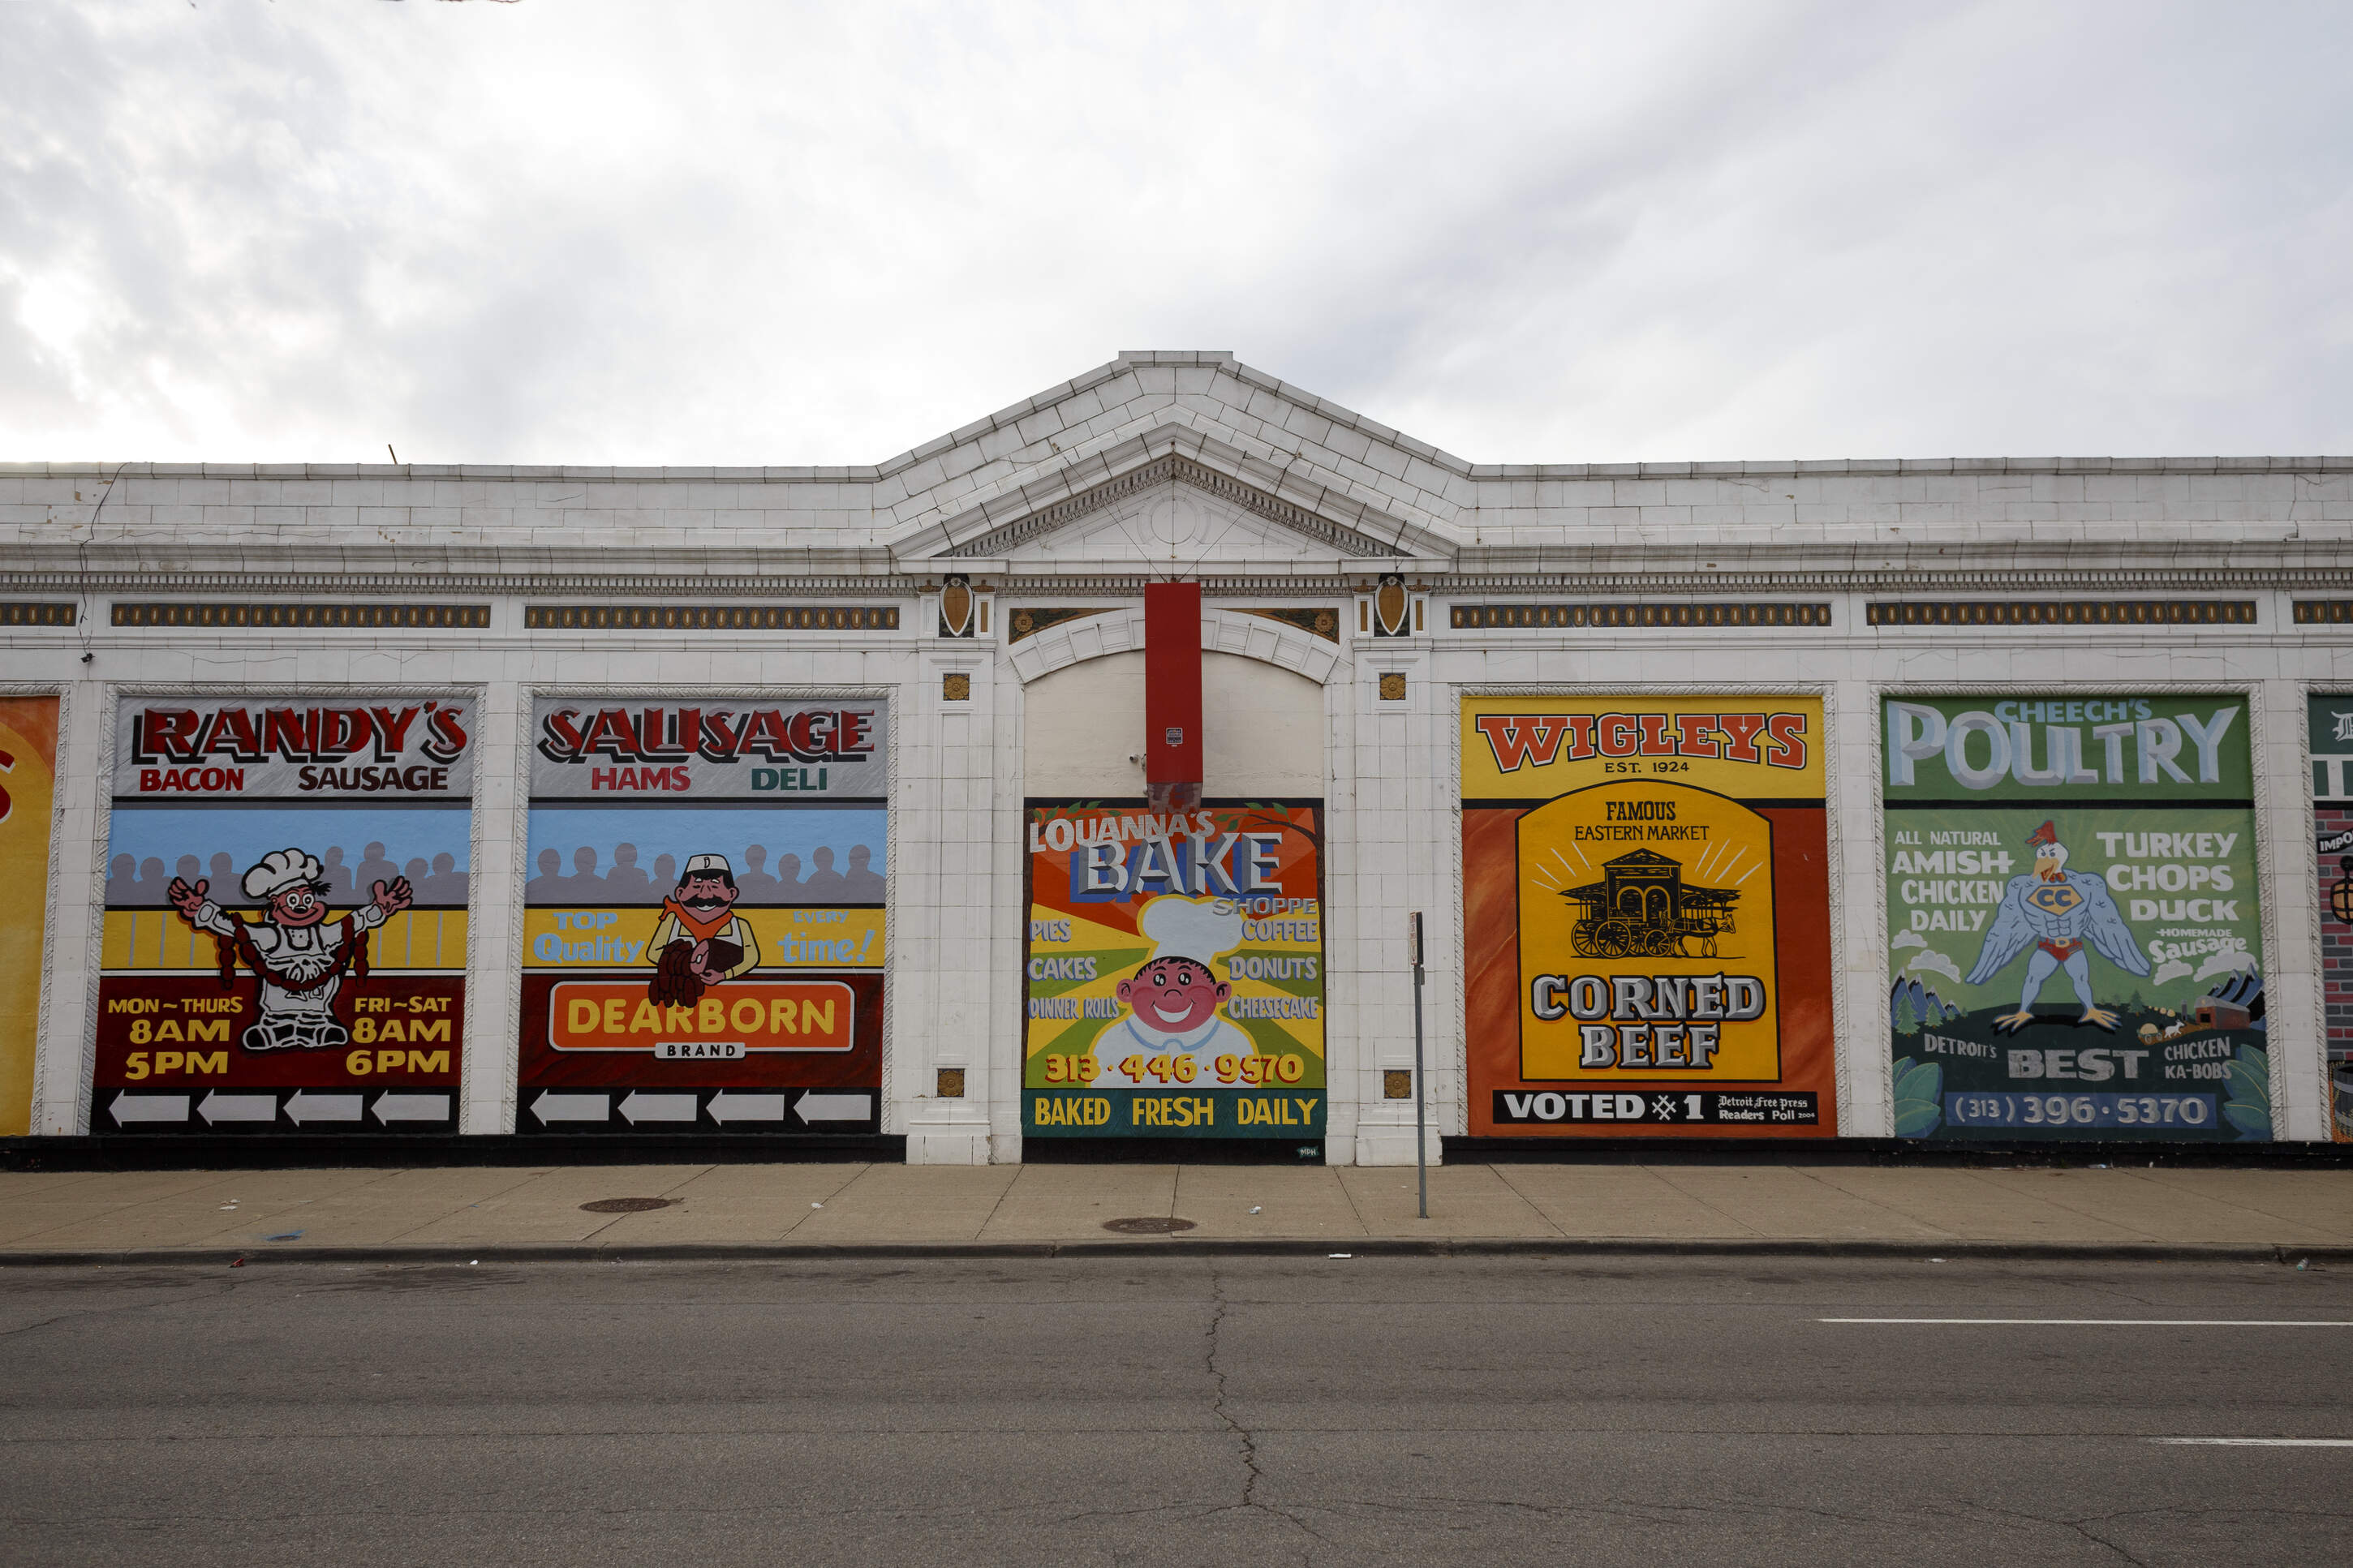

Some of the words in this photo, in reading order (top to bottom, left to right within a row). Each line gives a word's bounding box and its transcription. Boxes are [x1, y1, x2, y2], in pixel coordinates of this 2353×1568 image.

[1994, 699, 2152, 724] CHEECH'S
[132, 700, 467, 765] RANDY'S
[537, 706, 875, 764] SAUSAGE
[1886, 700, 2241, 789] POULTRY
[140, 767, 243, 792] BACON
[298, 765, 448, 792] SAUSAGE
[591, 765, 691, 791] HAMS
[751, 768, 828, 791] DELI
[1604, 762, 1641, 774] EST.
[1652, 761, 1689, 773] 1924
[1605, 801, 1675, 821] FAMOUS
[1030, 811, 1216, 853] LOUANNA'S
[1574, 825, 1644, 840] EASTERN
[1647, 824, 1710, 840] MARKET
[1895, 831, 1922, 845] ALL
[1930, 831, 2002, 845] NATURAL
[2097, 831, 2238, 858] TURKEY
[2320, 831, 2353, 852] IMPO
[1070, 832, 1282, 903] BAKE
[1892, 849, 2015, 874] AMISH
[2106, 865, 2235, 892] CHOPS
[1901, 879, 2004, 904] CHICKEN
[2036, 889, 2072, 908] CC
[793, 910, 850, 924] EVERY
[1212, 897, 1317, 916] SHOPPE
[2130, 899, 2239, 921] DUCK
[553, 912, 618, 930] TOP
[1030, 919, 1071, 943] PIES
[1241, 919, 1318, 942] COFFEE
[1911, 909, 1986, 932] DAILY
[2156, 929, 2232, 937] HOMEMADE
[533, 933, 645, 964] Quality
[776, 930, 876, 964] time!
[2148, 936, 2247, 964] Sausage
[1027, 957, 1098, 982] CAKES
[1228, 956, 1317, 981] DONUTS
[1028, 997, 1078, 1020] DINNER
[1084, 997, 1120, 1020] ROLLS
[1227, 995, 1318, 1020] CHEESECAKE
[1531, 972, 1766, 1023] CORNED
[567, 999, 835, 1035] DEARBORN
[129, 1019, 230, 1044] 8AM
[351, 1017, 451, 1043] 8AM
[667, 1045, 736, 1057] BRAND
[1579, 1022, 1721, 1072] BEEF
[2164, 1036, 2230, 1061] CHICKEN
[125, 1051, 229, 1080] 5PM
[346, 1049, 450, 1076] 6PM
[2007, 1049, 2149, 1081] BEST
[2165, 1061, 2232, 1080] KA-BOBS
[1035, 1098, 1111, 1126] BAKED
[1133, 1097, 1214, 1126] FRESH
[1237, 1098, 1318, 1125] DAILY
[1503, 1093, 1645, 1119] VOTED
[1719, 1095, 1753, 1108] Detroit
[1754, 1097, 1778, 1109] Free
[1719, 1110, 1765, 1119] Readers
[1772, 1110, 1795, 1120] Poll
